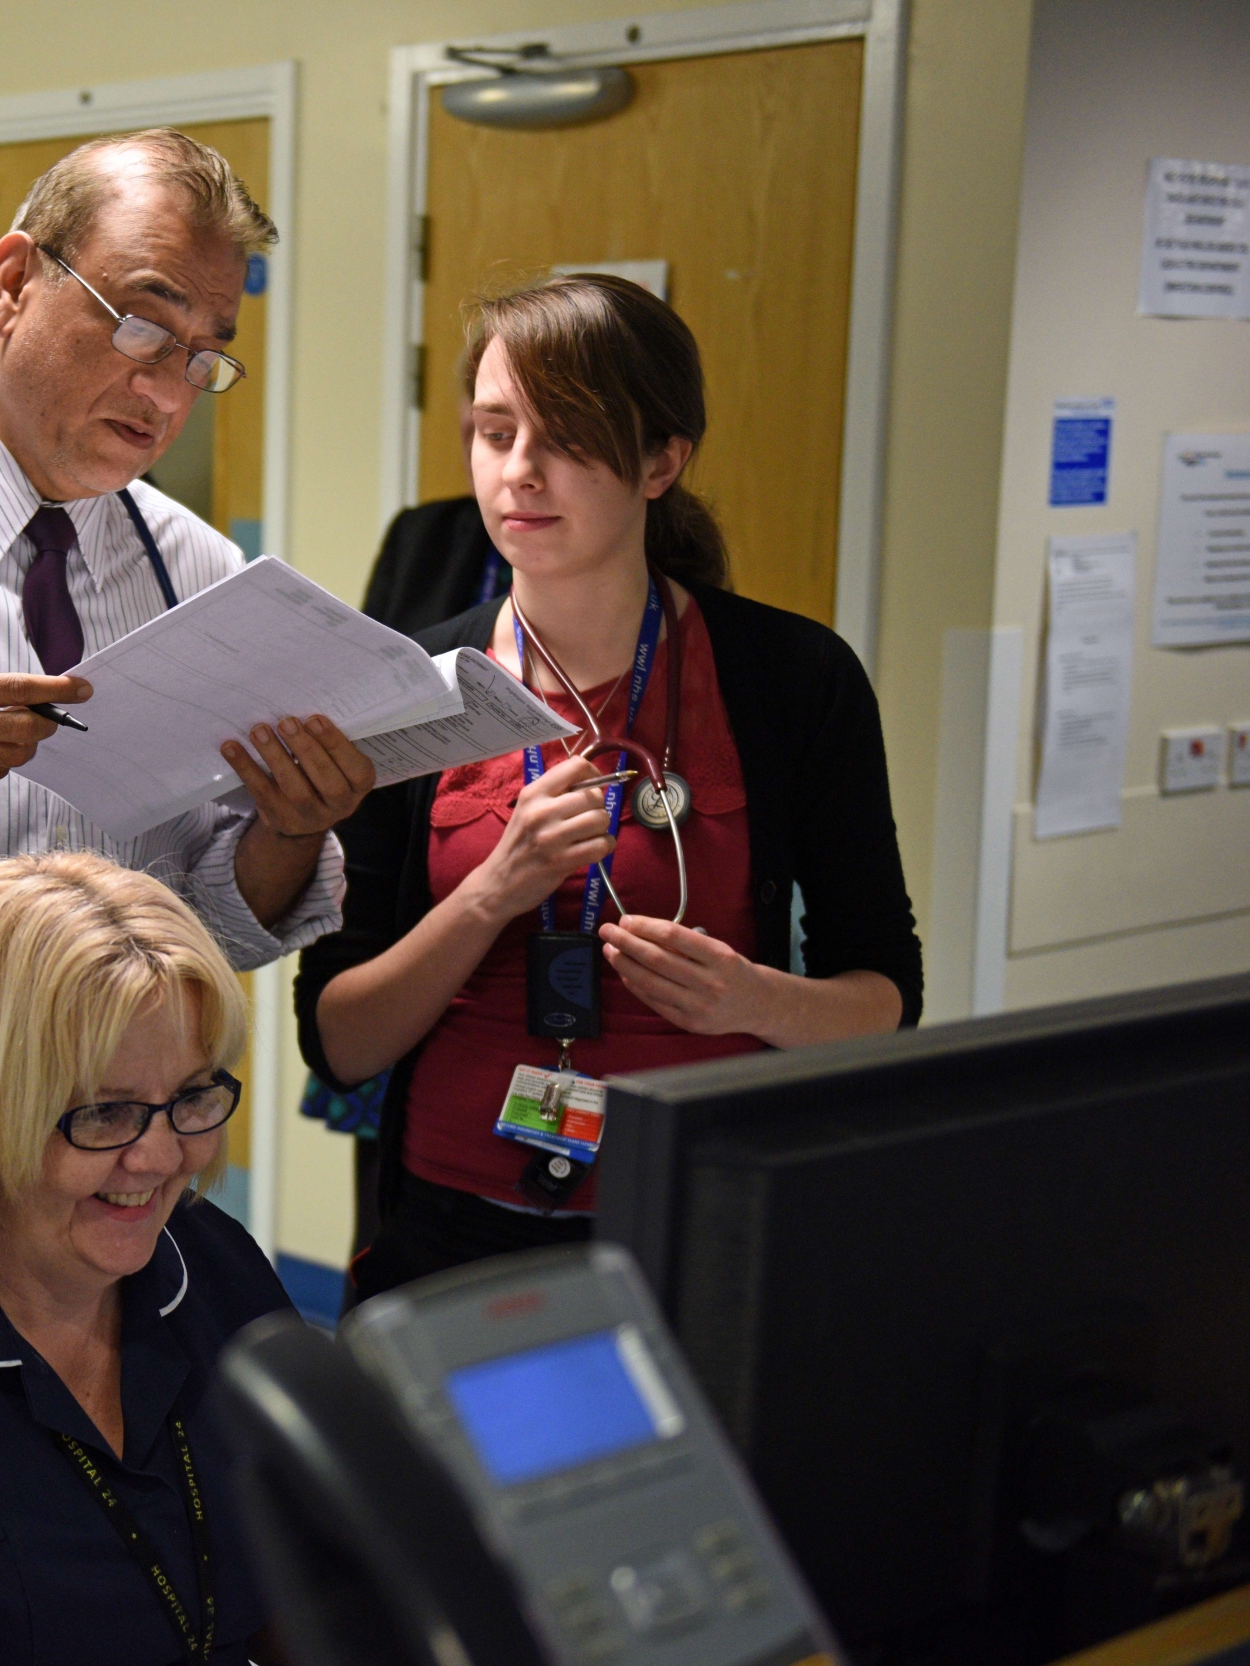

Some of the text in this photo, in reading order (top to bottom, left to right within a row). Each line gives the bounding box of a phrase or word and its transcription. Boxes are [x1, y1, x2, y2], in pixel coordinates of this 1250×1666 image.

[62, 1434, 102, 1488] OSPITAL
[181, 1445, 203, 1520] HOSPITAL
[151, 1565, 190, 1633] HOSPITAL
